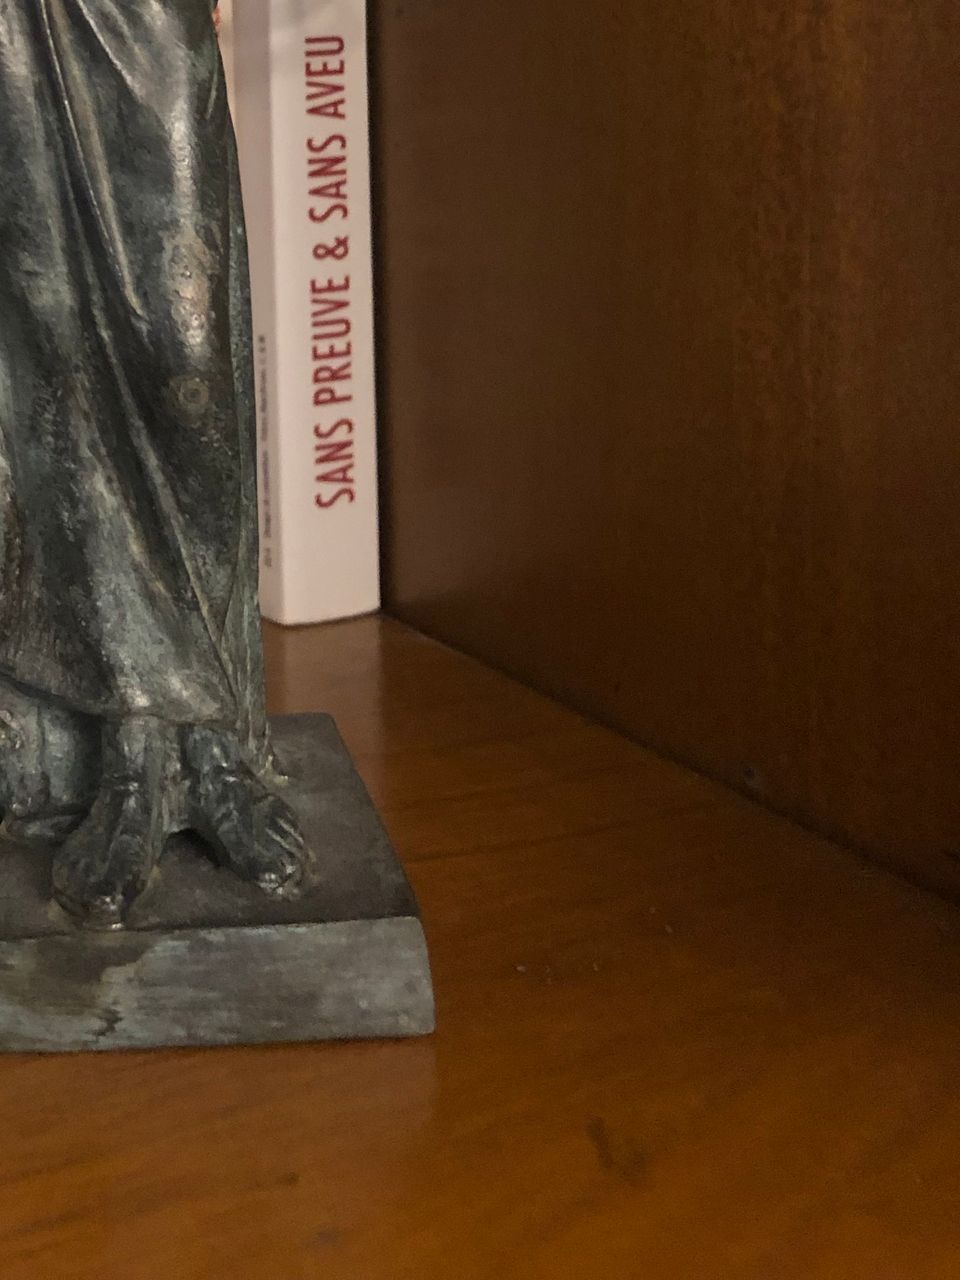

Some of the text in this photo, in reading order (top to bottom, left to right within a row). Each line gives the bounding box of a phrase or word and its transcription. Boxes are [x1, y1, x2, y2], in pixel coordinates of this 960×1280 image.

[305, 35, 354, 509] SANS PREUVE & SANS AVEU
